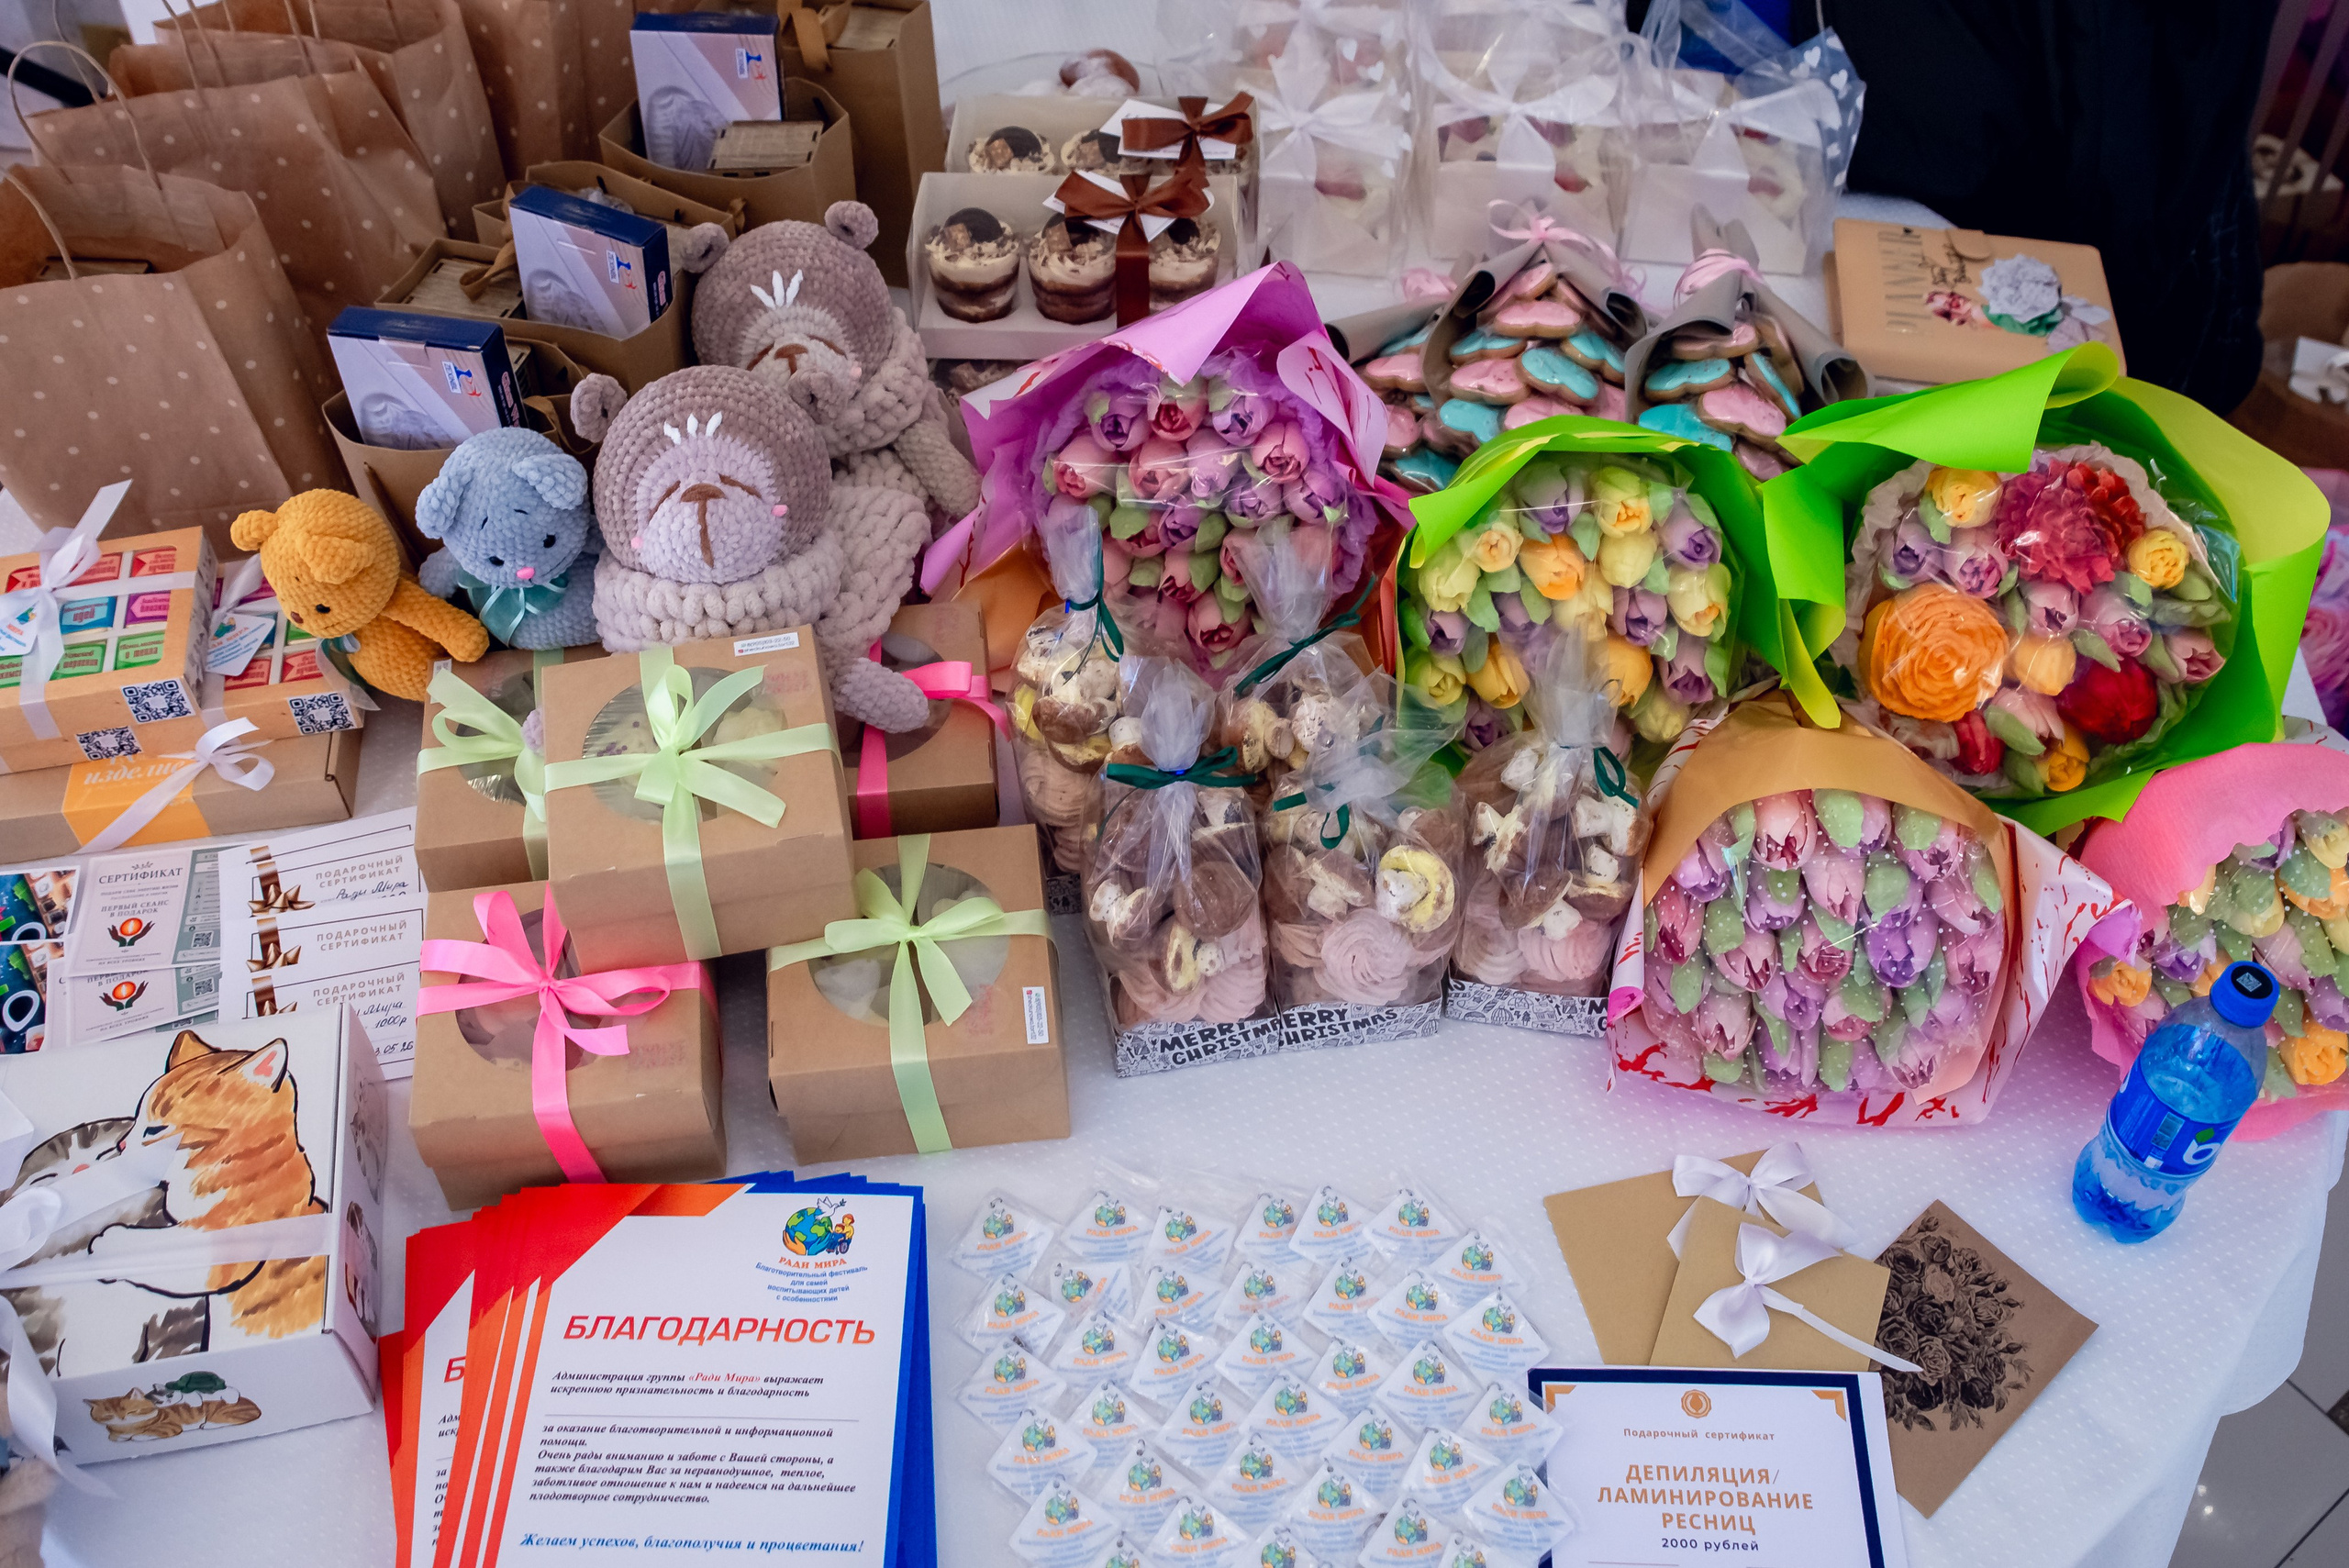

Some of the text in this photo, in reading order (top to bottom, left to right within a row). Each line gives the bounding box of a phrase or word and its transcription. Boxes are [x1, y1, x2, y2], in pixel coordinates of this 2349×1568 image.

[316, 854, 403, 880] ПОДАРОЧНЫЙ
[98, 867, 183, 884] СЕРТИФИКАТ
[319, 866, 400, 888] СЕРТИФИКАТ
[101, 899, 170, 913] ПЕРВЫЙ СЕАНС
[117, 907, 159, 917] ПОДАРОК
[317, 919, 406, 941] ПОДАРОЧНЫЙ
[320, 932, 404, 951] СЕРТИФИКАТ
[313, 972, 405, 997] ПОДАРОЧНЫЙ
[317, 984, 402, 1006] СЕРТИФИКАТ
[755, 1262, 868, 1278] Благотворительный фестиваль
[778, 1256, 847, 1269] РАДИ МИРА
[767, 1284, 850, 1296] воспитывающих детей
[782, 1295, 838, 1303] особенностями
[562, 1315, 875, 1347] БЛАГОДАРНОСТЬ
[551, 1371, 824, 1385] Администрация группы «Ради Мира» выражает
[551, 1385, 613, 1396] искреннюю
[616, 1385, 715, 1397] признательность
[728, 1386, 810, 1398] благодарность
[542, 1425, 554, 1433] за
[557, 1425, 607, 1433] оказание
[609, 1424, 721, 1436] благотворительной
[735, 1427, 834, 1438] информационной
[1623, 1428, 1776, 1442] Подарочный сертификат
[540, 1439, 587, 1447] помощи.
[538, 1450, 572, 1460] Очень
[573, 1451, 602, 1462] рады
[606, 1453, 664, 1462] вниманию
[677, 1451, 718, 1462] заботе
[729, 1452, 767, 1463] Вашей
[770, 1456, 824, 1465] стороны,
[535, 1464, 575, 1473] также
[578, 1463, 642, 1475] благодарим
[646, 1465, 667, 1474] Вас
[685, 1466, 774, 1478] неравнодушное,
[781, 1470, 825, 1479] теплое,
[1625, 1463, 1780, 1485] ДЕПИЛЯЦИЯ/
[532, 1477, 597, 1487] заботливое
[600, 1480, 667, 1488] отношение
[679, 1481, 702, 1489] нам
[715, 1481, 768, 1490] надеемся
[771, 1483, 785, 1491] на
[787, 1482, 856, 1493] дальнейшее
[529, 1491, 710, 1505] плодотворное сотрудничество.
[1597, 1486, 1814, 1510] ЛАМИНИРОВАНИЕ
[1662, 1513, 1756, 1535] РЕСНИЦ
[519, 1533, 864, 1553] Желаем успехов, благополучия и процветания!
[1661, 1538, 1759, 1551] 2000 рублей
